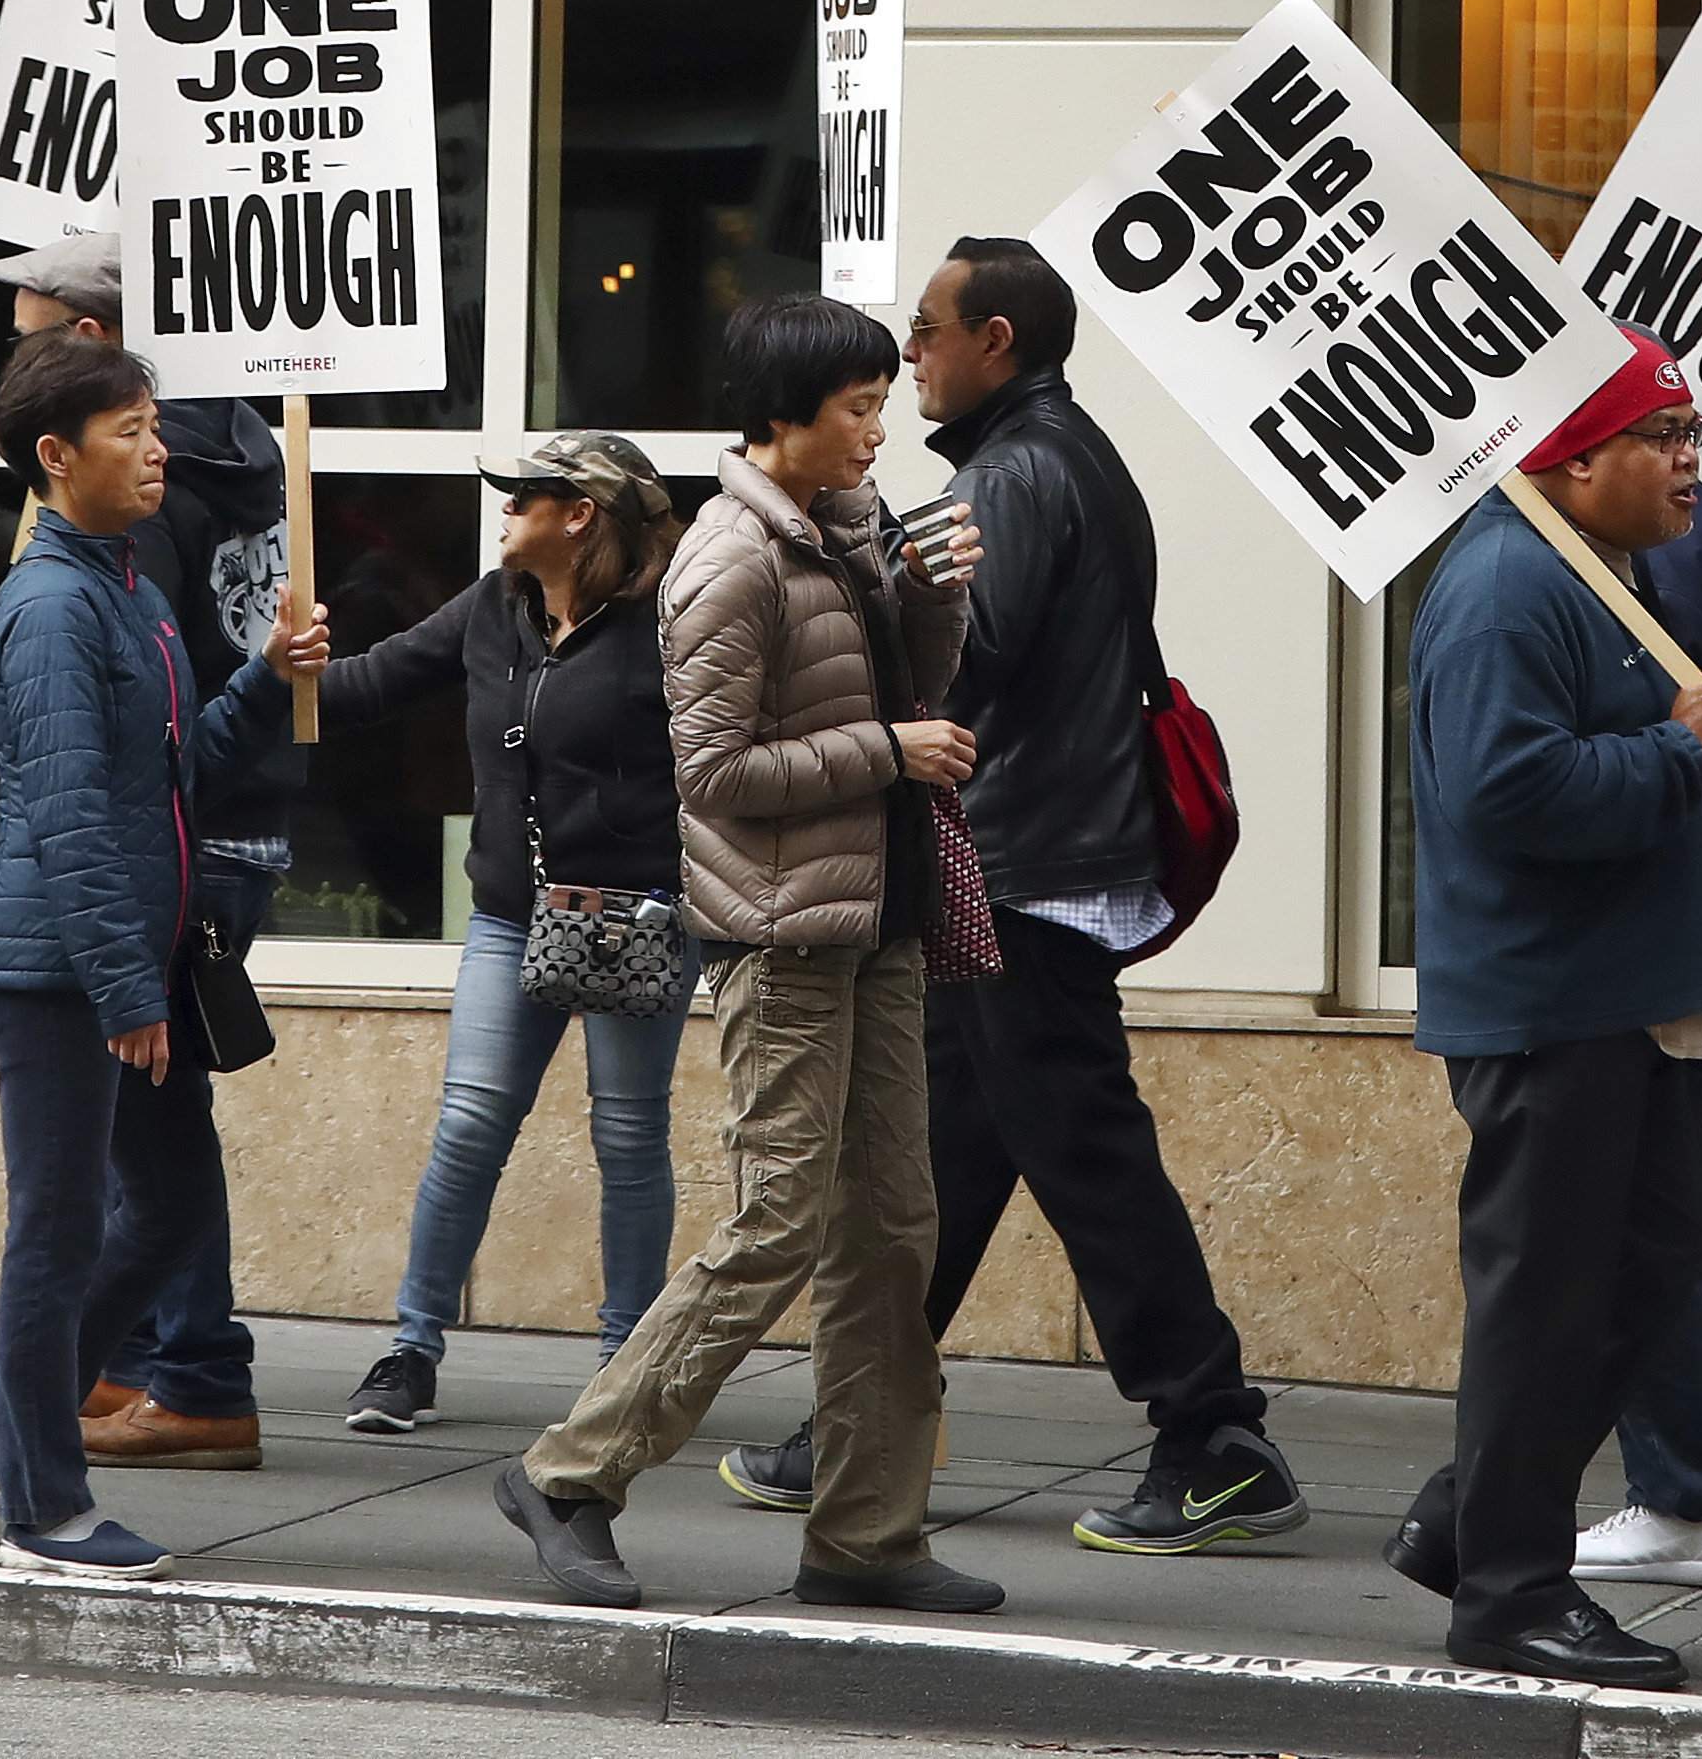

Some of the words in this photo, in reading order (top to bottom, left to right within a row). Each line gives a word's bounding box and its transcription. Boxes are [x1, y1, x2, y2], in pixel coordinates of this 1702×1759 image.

[177, 43, 382, 102] JOB
[837, 69, 850, 101] BE
[205, 107, 363, 144] SHOULD
[262, 150, 310, 183] BE
[1092, 45, 1350, 293] ONE
[1186, 137, 1372, 322] JOB
[153, 188, 417, 335] ENOUGH
[1236, 201, 1384, 342] SHOULD
[1311, 271, 1372, 332] BE
[245, 357, 335, 373] UNITEHERE!
[1250, 219, 1567, 530] ENOUGH
[1438, 415, 1519, 493] UNITEHERE!
[1126, 1647, 1300, 1672] TOW
[1343, 1665, 1577, 1694] AWAY
